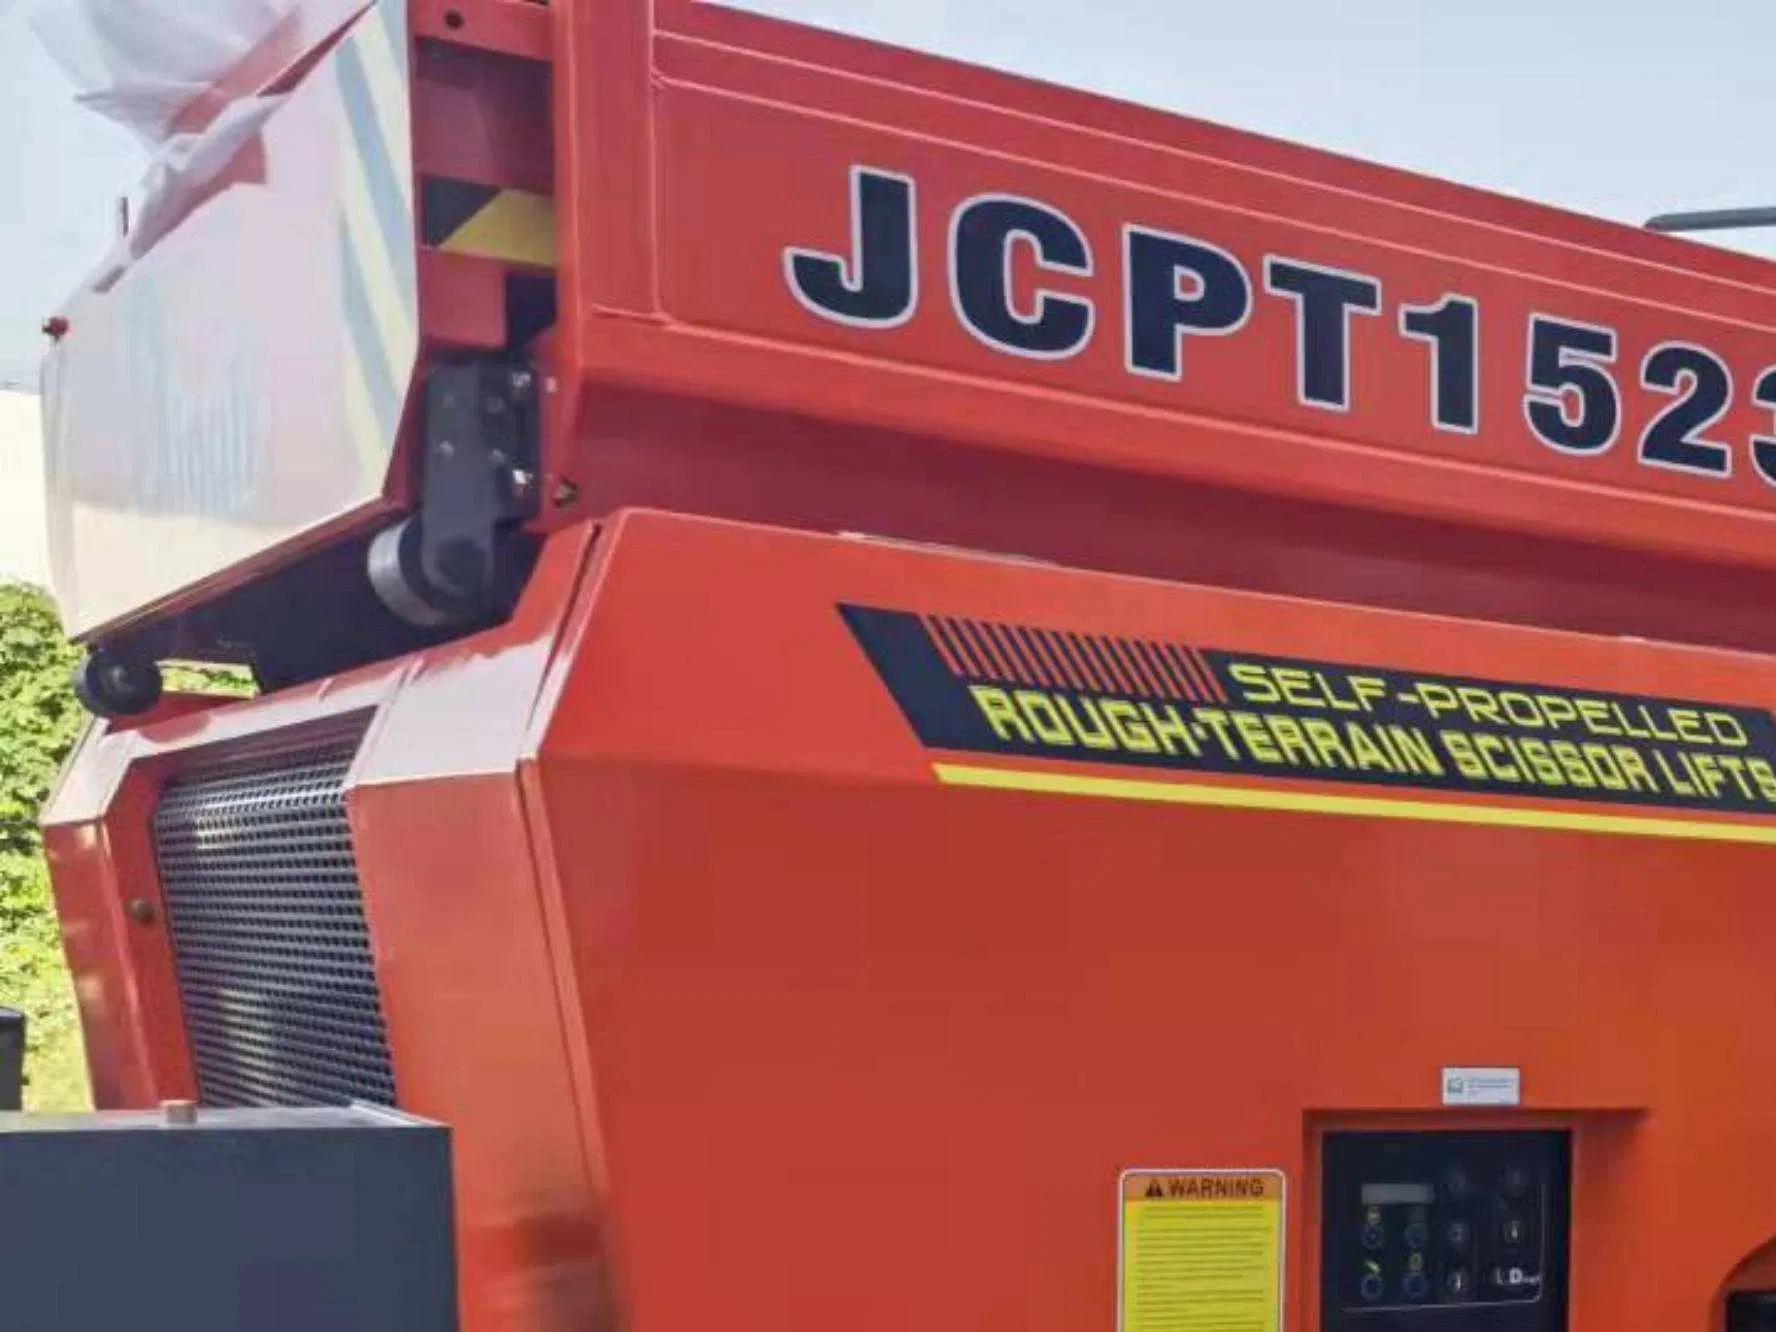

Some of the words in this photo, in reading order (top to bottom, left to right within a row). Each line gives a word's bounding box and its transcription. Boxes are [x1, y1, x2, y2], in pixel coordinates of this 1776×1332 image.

[969, 684, 1445, 777] ROUGH-TERRAIN
[1441, 730, 1660, 793] SCISSOR
[1226, 661, 1749, 748] SELF-PROPELLED
[1168, 1178, 1264, 1198] WARNING
